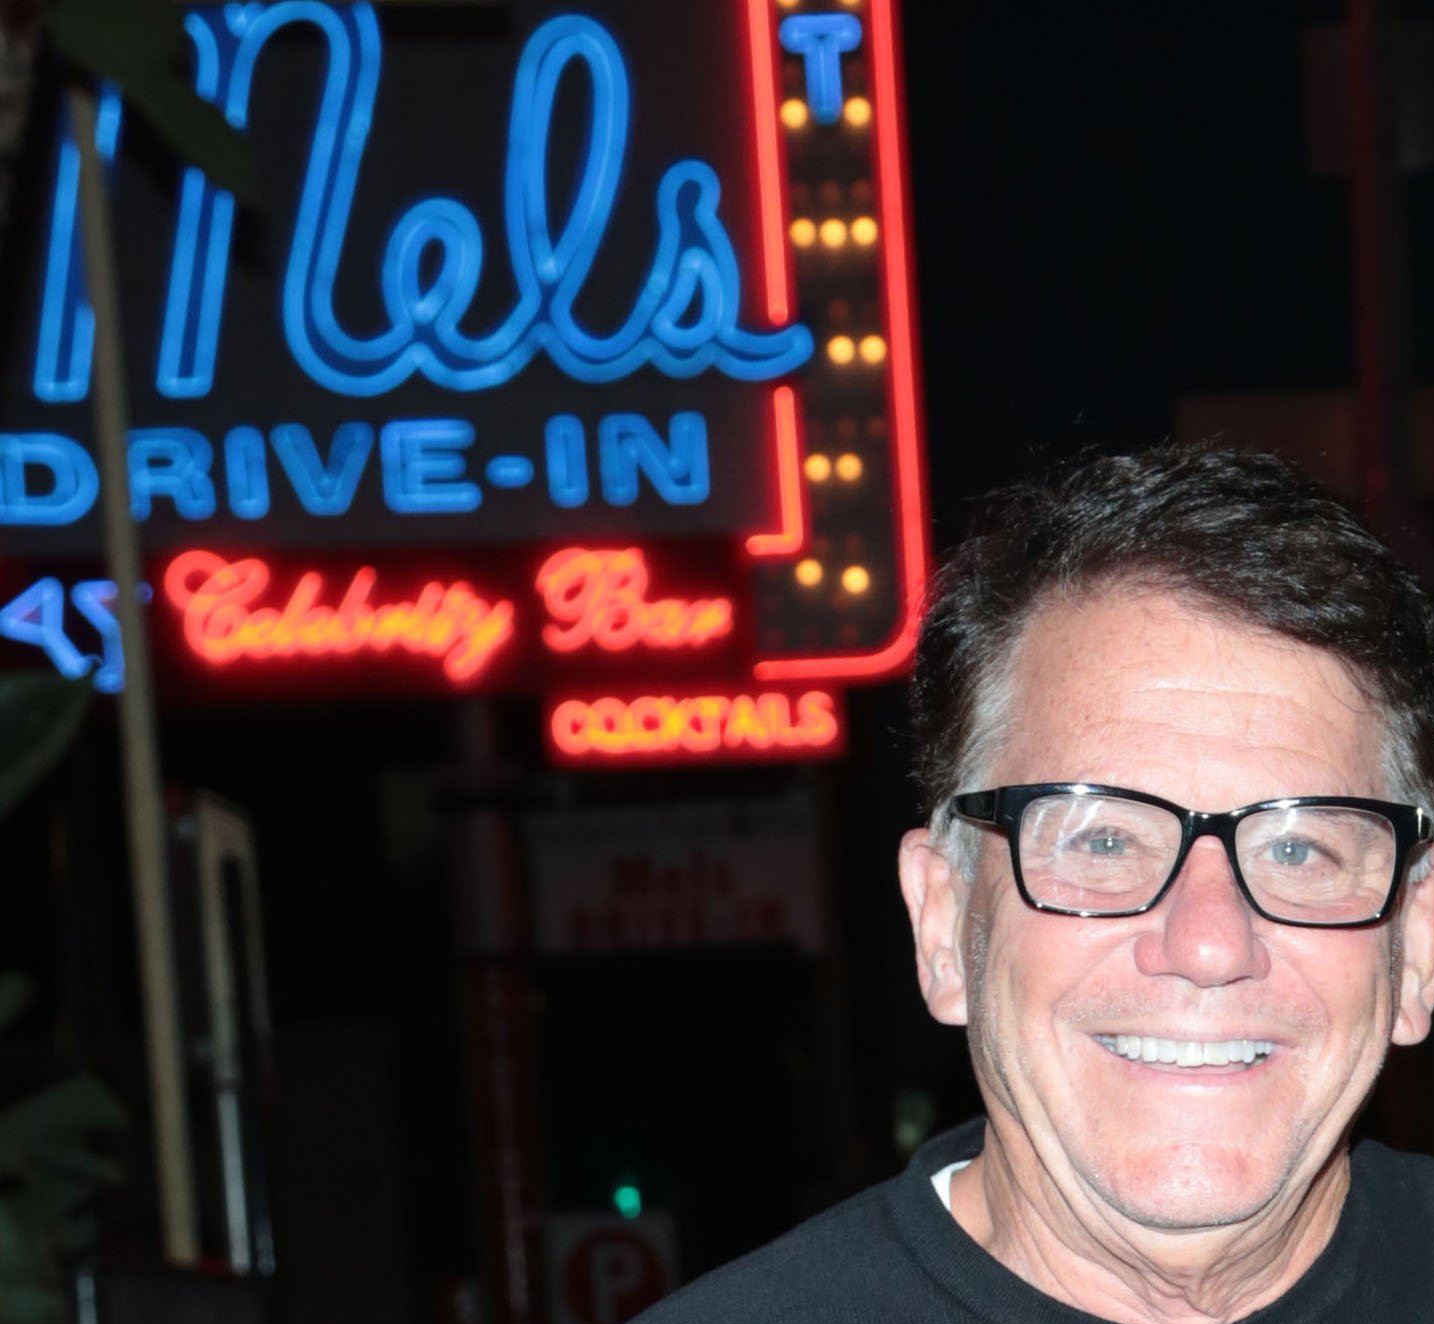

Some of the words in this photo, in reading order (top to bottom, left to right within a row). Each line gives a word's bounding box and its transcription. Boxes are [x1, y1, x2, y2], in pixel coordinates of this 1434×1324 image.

[779, 13, 862, 122] T
[33, 0, 813, 401] Mels
[0, 411, 709, 526] DRIVE-IN
[163, 549, 514, 683] Celebrity
[535, 547, 732, 652] Bar
[552, 691, 838, 754] COCKTAILS
